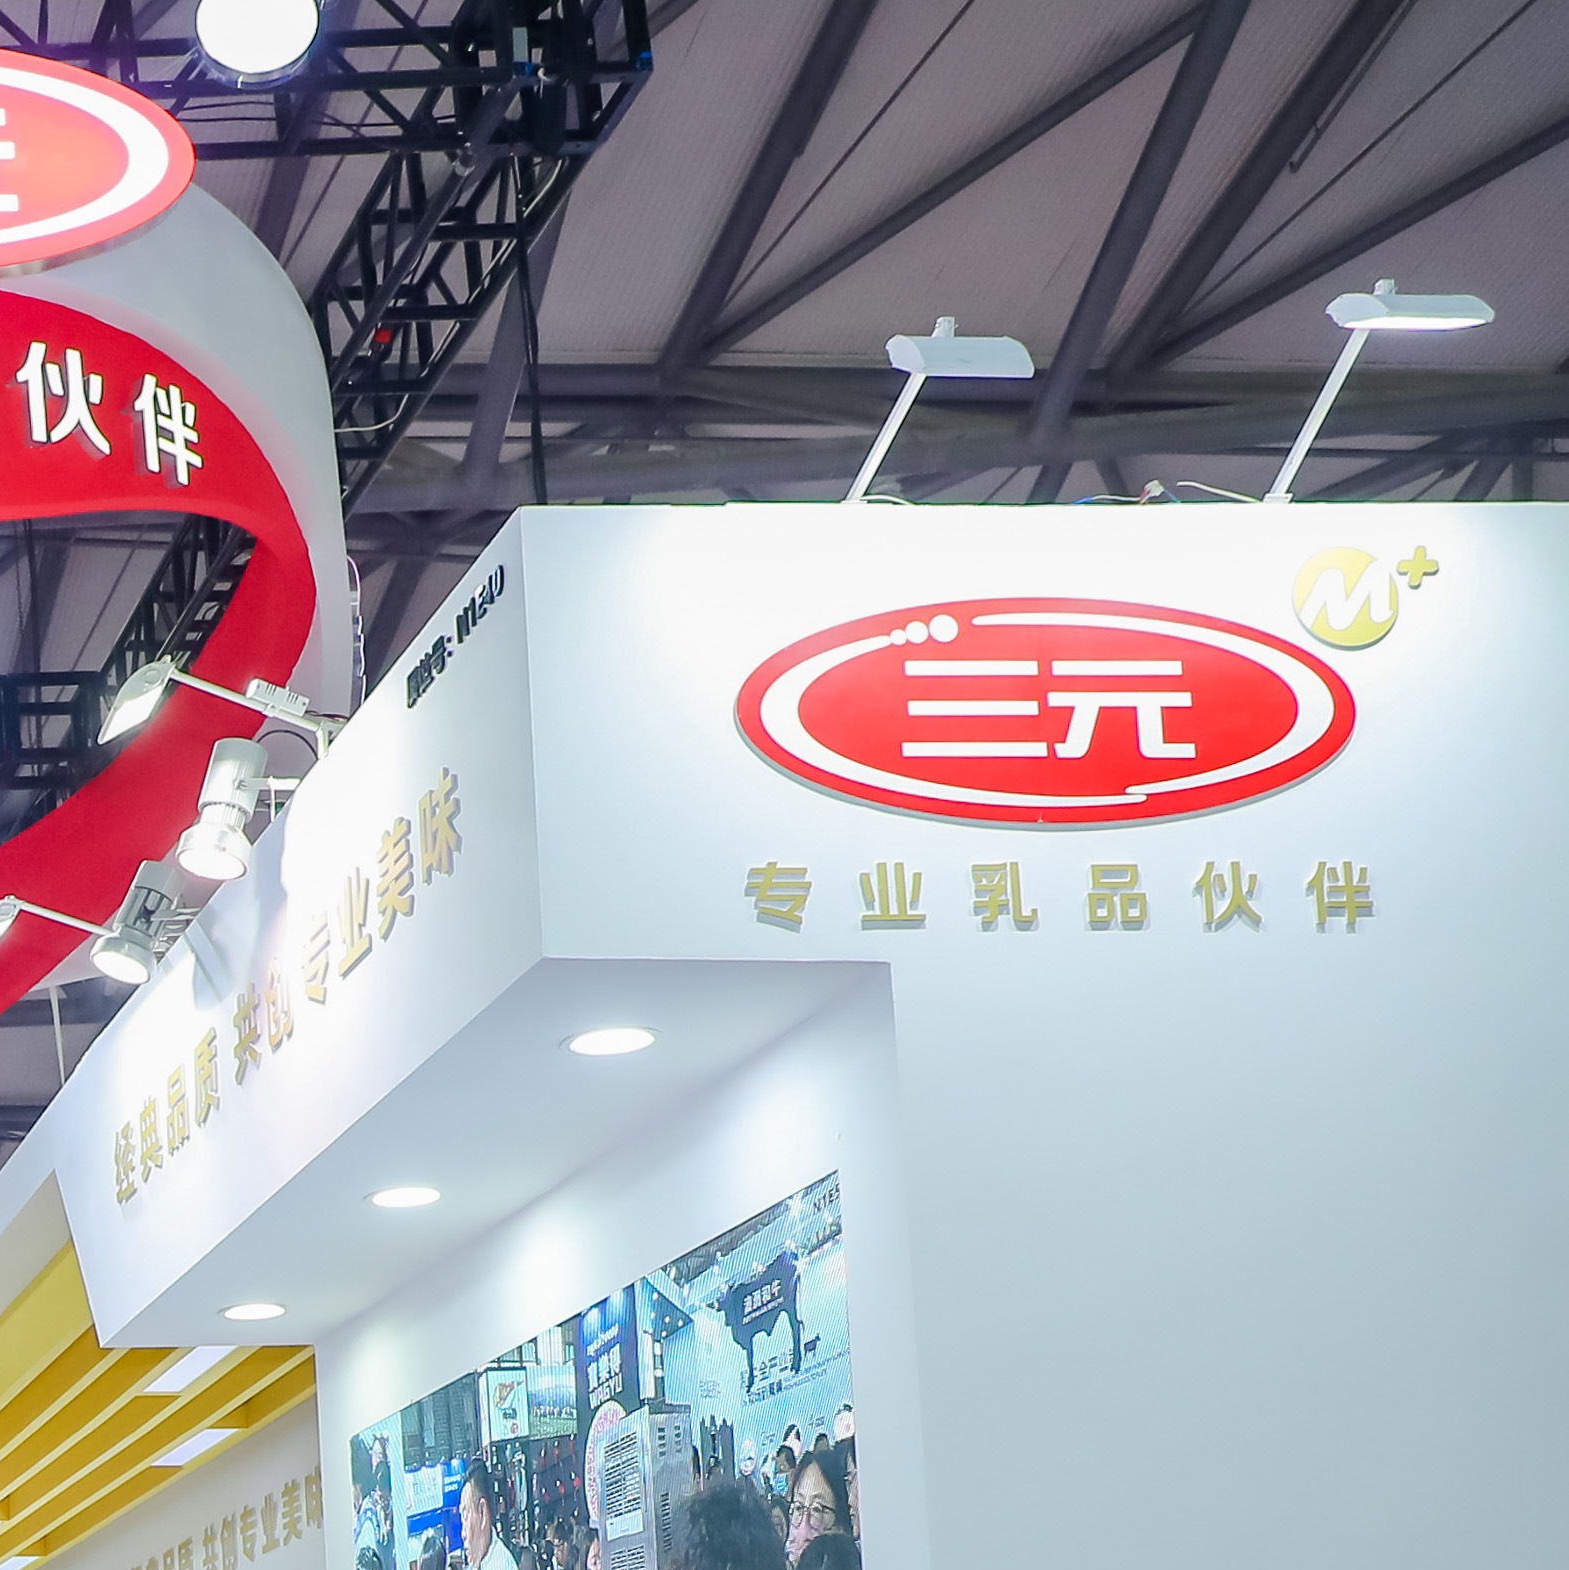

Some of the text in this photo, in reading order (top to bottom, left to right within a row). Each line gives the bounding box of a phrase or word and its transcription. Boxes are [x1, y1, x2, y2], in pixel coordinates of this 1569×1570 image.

[901, 660, 1197, 758] 三元
[745, 861, 1375, 931] 专业乳品伙伴
